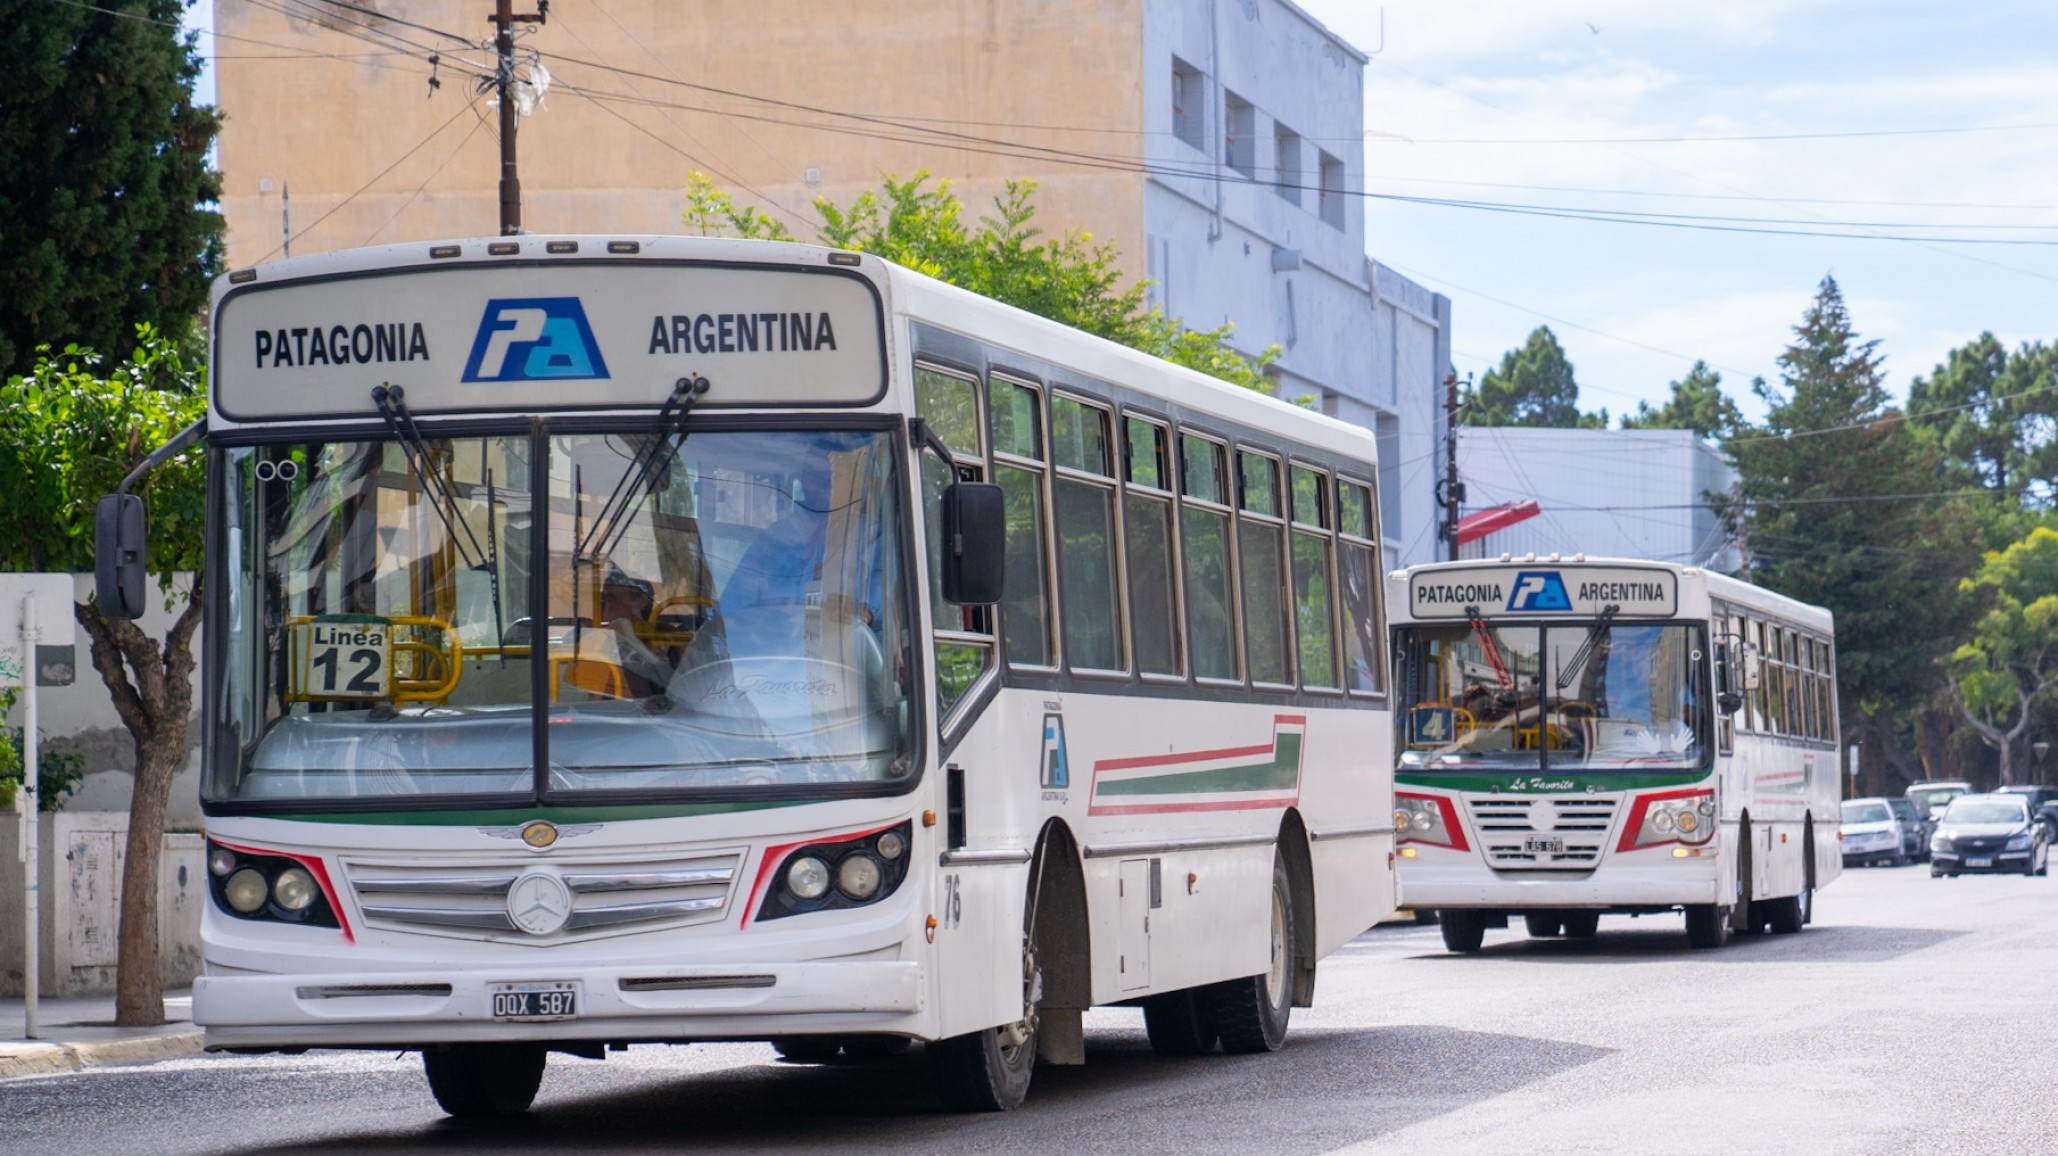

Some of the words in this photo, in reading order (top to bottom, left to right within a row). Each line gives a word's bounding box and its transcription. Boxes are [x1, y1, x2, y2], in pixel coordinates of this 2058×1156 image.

[256, 322, 429, 369] PATAGONIA
[648, 311, 838, 355] ARGENTINA
[1417, 583, 1503, 604] PATAGONIA
[1578, 582, 1664, 602] ARGENTINA
[314, 626, 383, 647] Linea
[313, 647, 382, 693] 12
[1421, 711, 1447, 741] 4
[1509, 777, 1527, 791] La
[1529, 777, 1576, 790] Favorita
[944, 873, 961, 928] 76
[539, 991, 574, 1014] 587
